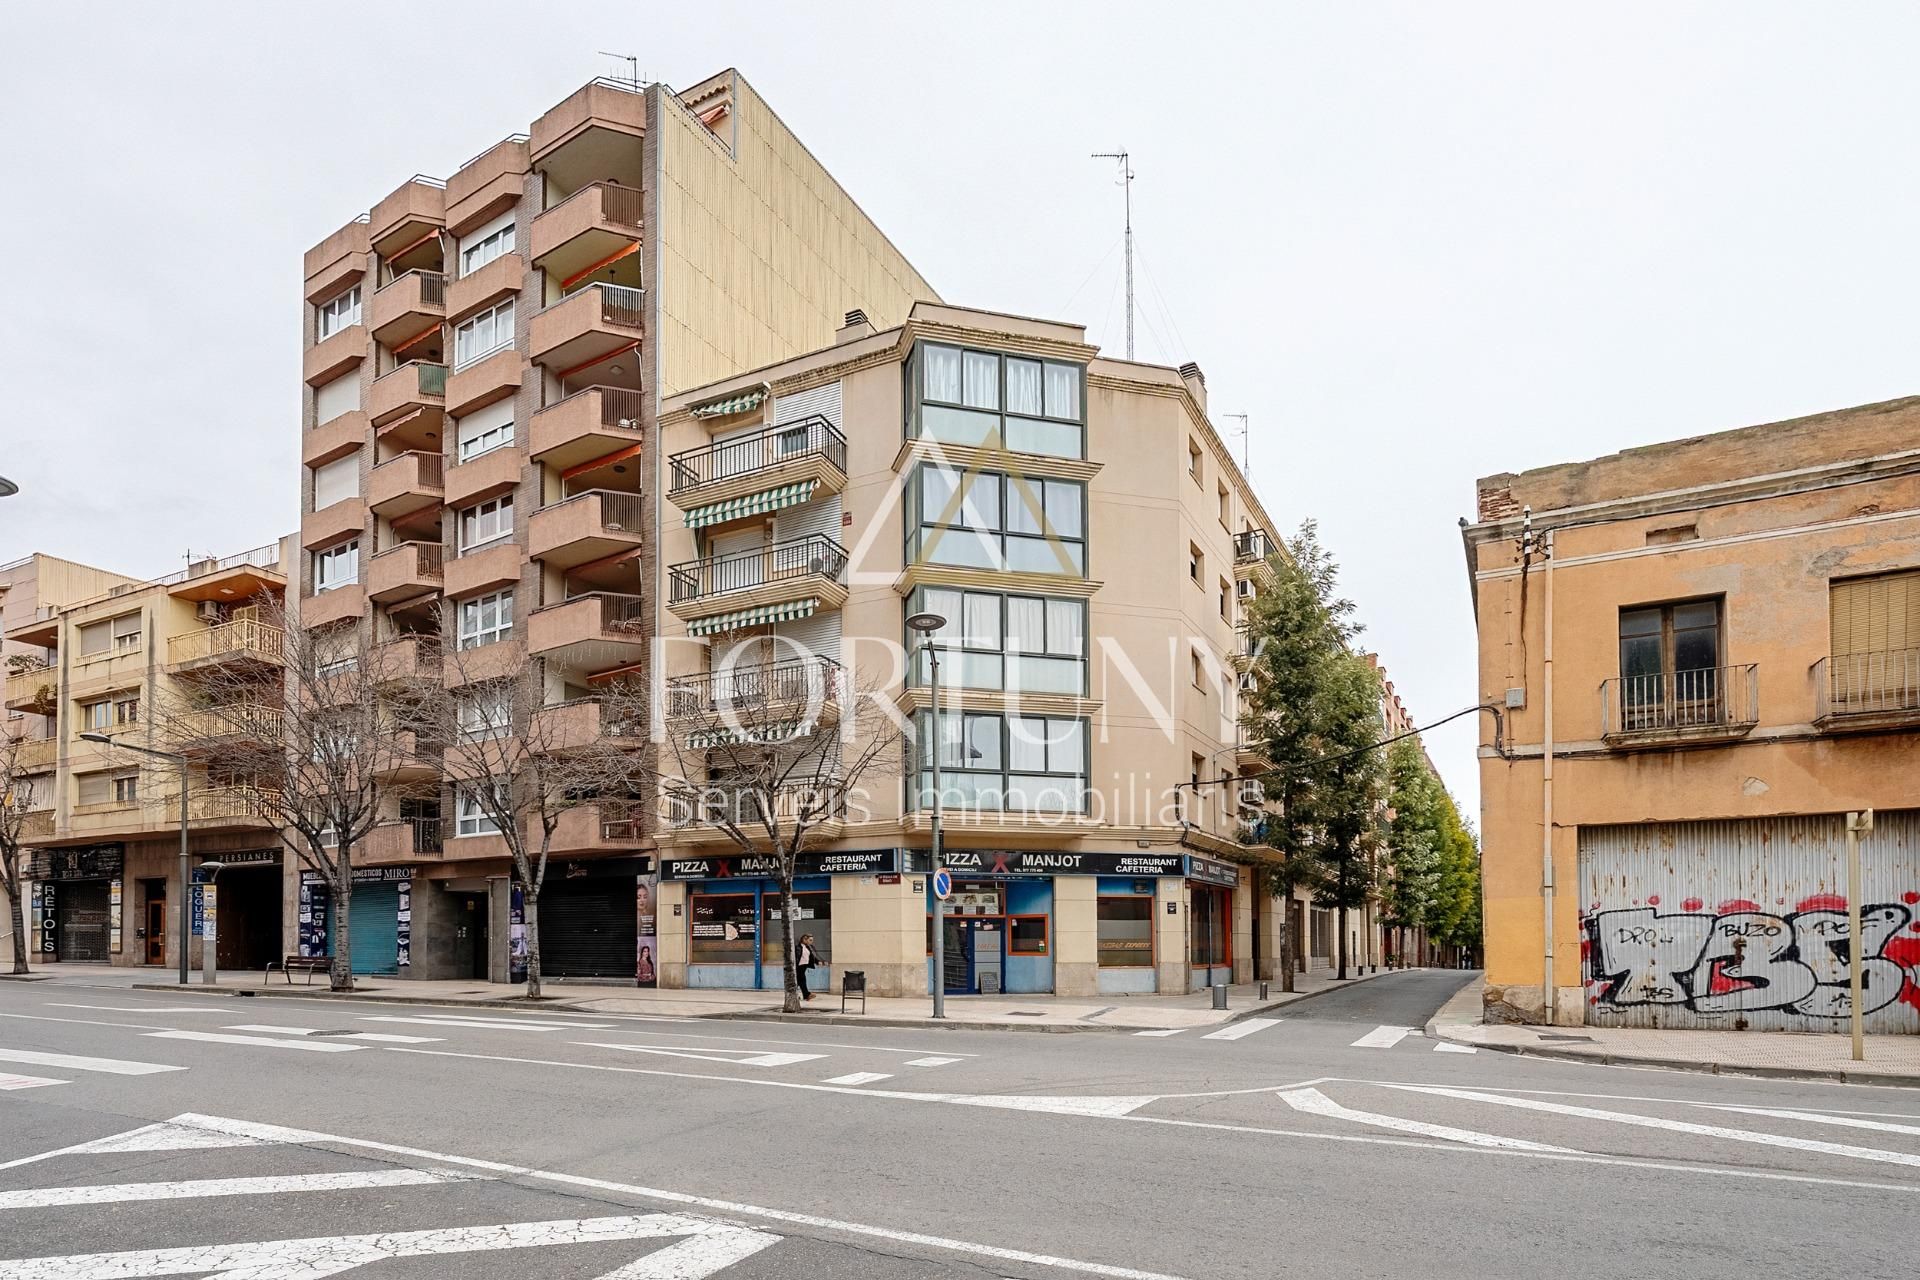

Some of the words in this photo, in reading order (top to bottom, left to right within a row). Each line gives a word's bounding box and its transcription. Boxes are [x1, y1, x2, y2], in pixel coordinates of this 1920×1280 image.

[825, 854, 882, 863] RESTAURANT
[943, 853, 982, 866] IZZA
[1022, 855, 1082, 867] MANJOT
[1121, 858, 1177, 866] RESTAURANT
[672, 861, 709, 873] PIZZA
[820, 863, 867, 872] CAFETERIA
[1719, 922, 1782, 938] BUZO
